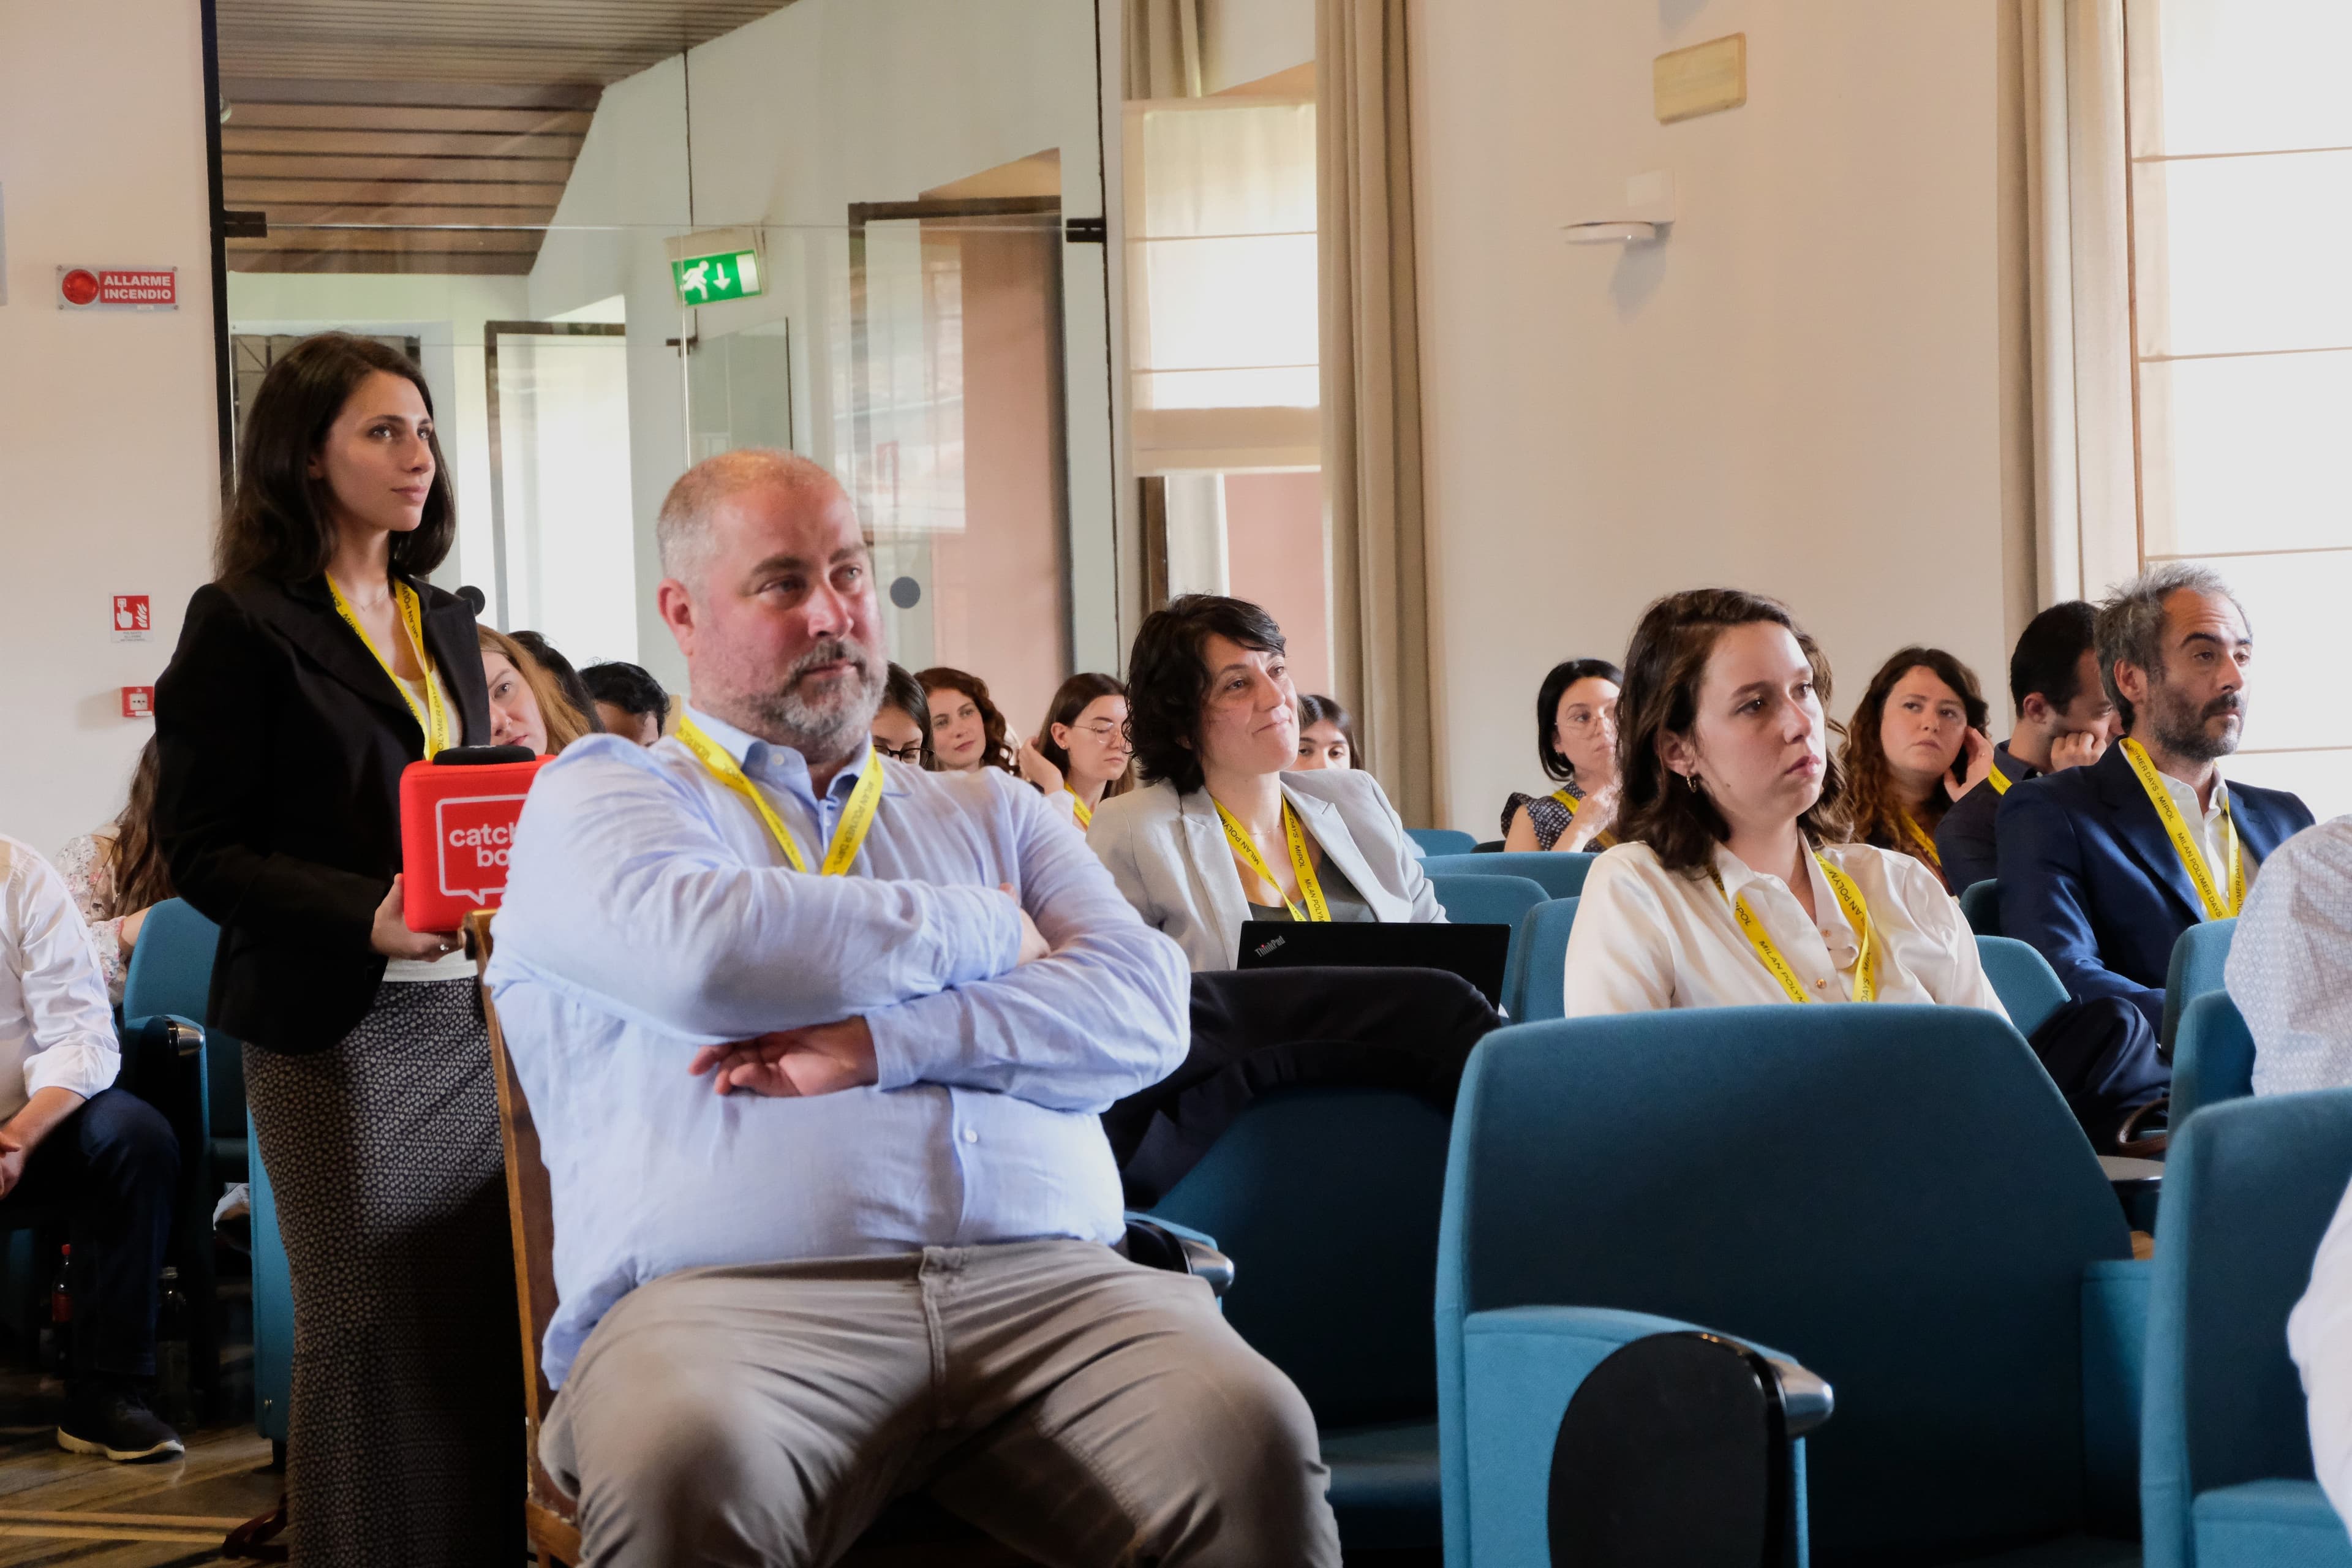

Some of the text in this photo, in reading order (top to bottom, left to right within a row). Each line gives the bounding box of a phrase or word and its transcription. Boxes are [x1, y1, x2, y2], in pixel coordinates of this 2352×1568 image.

[104, 275, 172, 287] ALLARME
[104, 288, 172, 300] INCENDIO
[2144, 771, 2159, 792] DAYS
[2158, 796, 2174, 822] MIPOL
[1241, 841, 1260, 865] MILAN
[1289, 816, 1299, 839] DAYS
[1294, 845, 1306, 868] MIPOL
[2176, 832, 2223, 918] MILAN POLYMER DAYS
[1304, 878, 1317, 899] MILAN
[1736, 901, 1752, 927] IPOL
[1254, 935, 1286, 957] ThinkPad
[1758, 940, 1784, 970] MILAN
